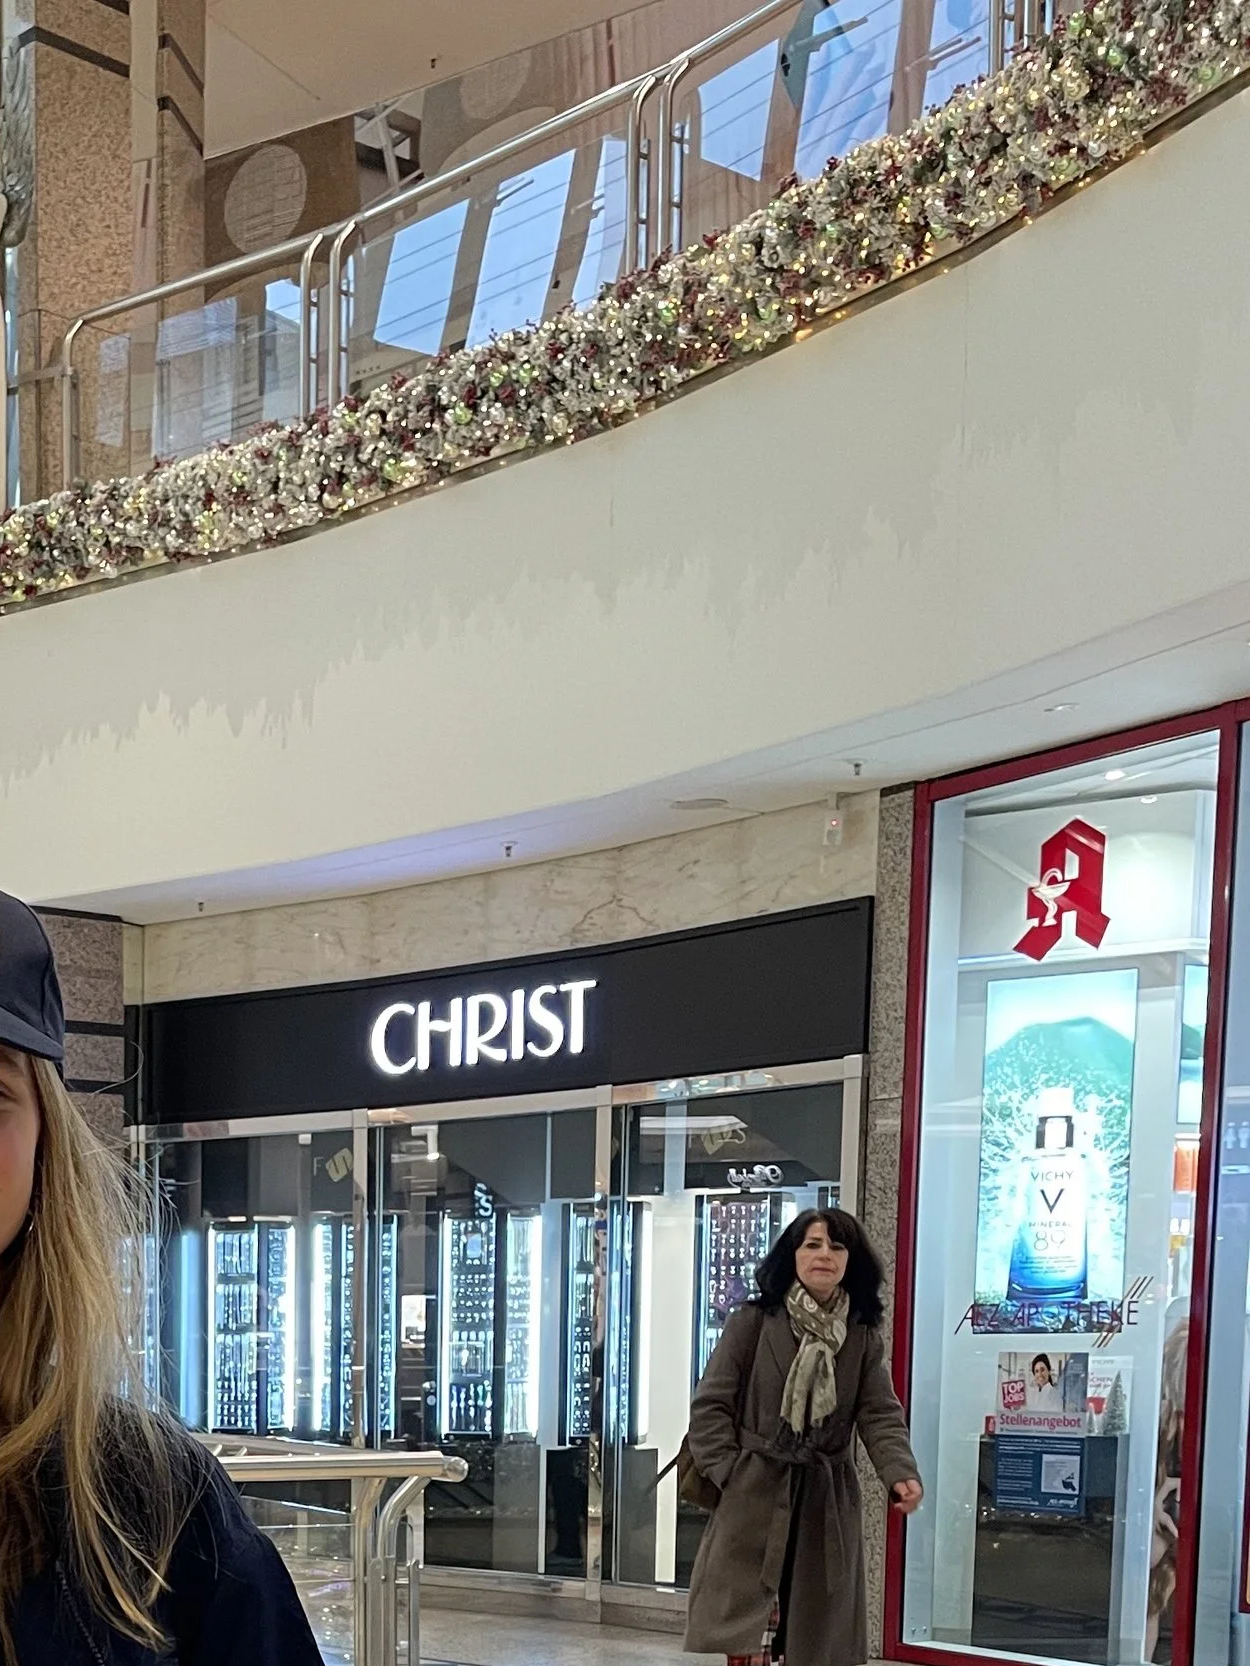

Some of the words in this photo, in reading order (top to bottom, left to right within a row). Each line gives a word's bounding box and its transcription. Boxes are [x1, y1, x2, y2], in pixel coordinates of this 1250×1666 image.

[370, 979, 597, 1075] CHRIST
[1030, 1170, 1074, 1181] VICHY
[1033, 1230, 1066, 1252] 89
[1002, 1382, 1025, 1394] TOP
[1000, 1413, 1082, 1430] Stellenangebot
